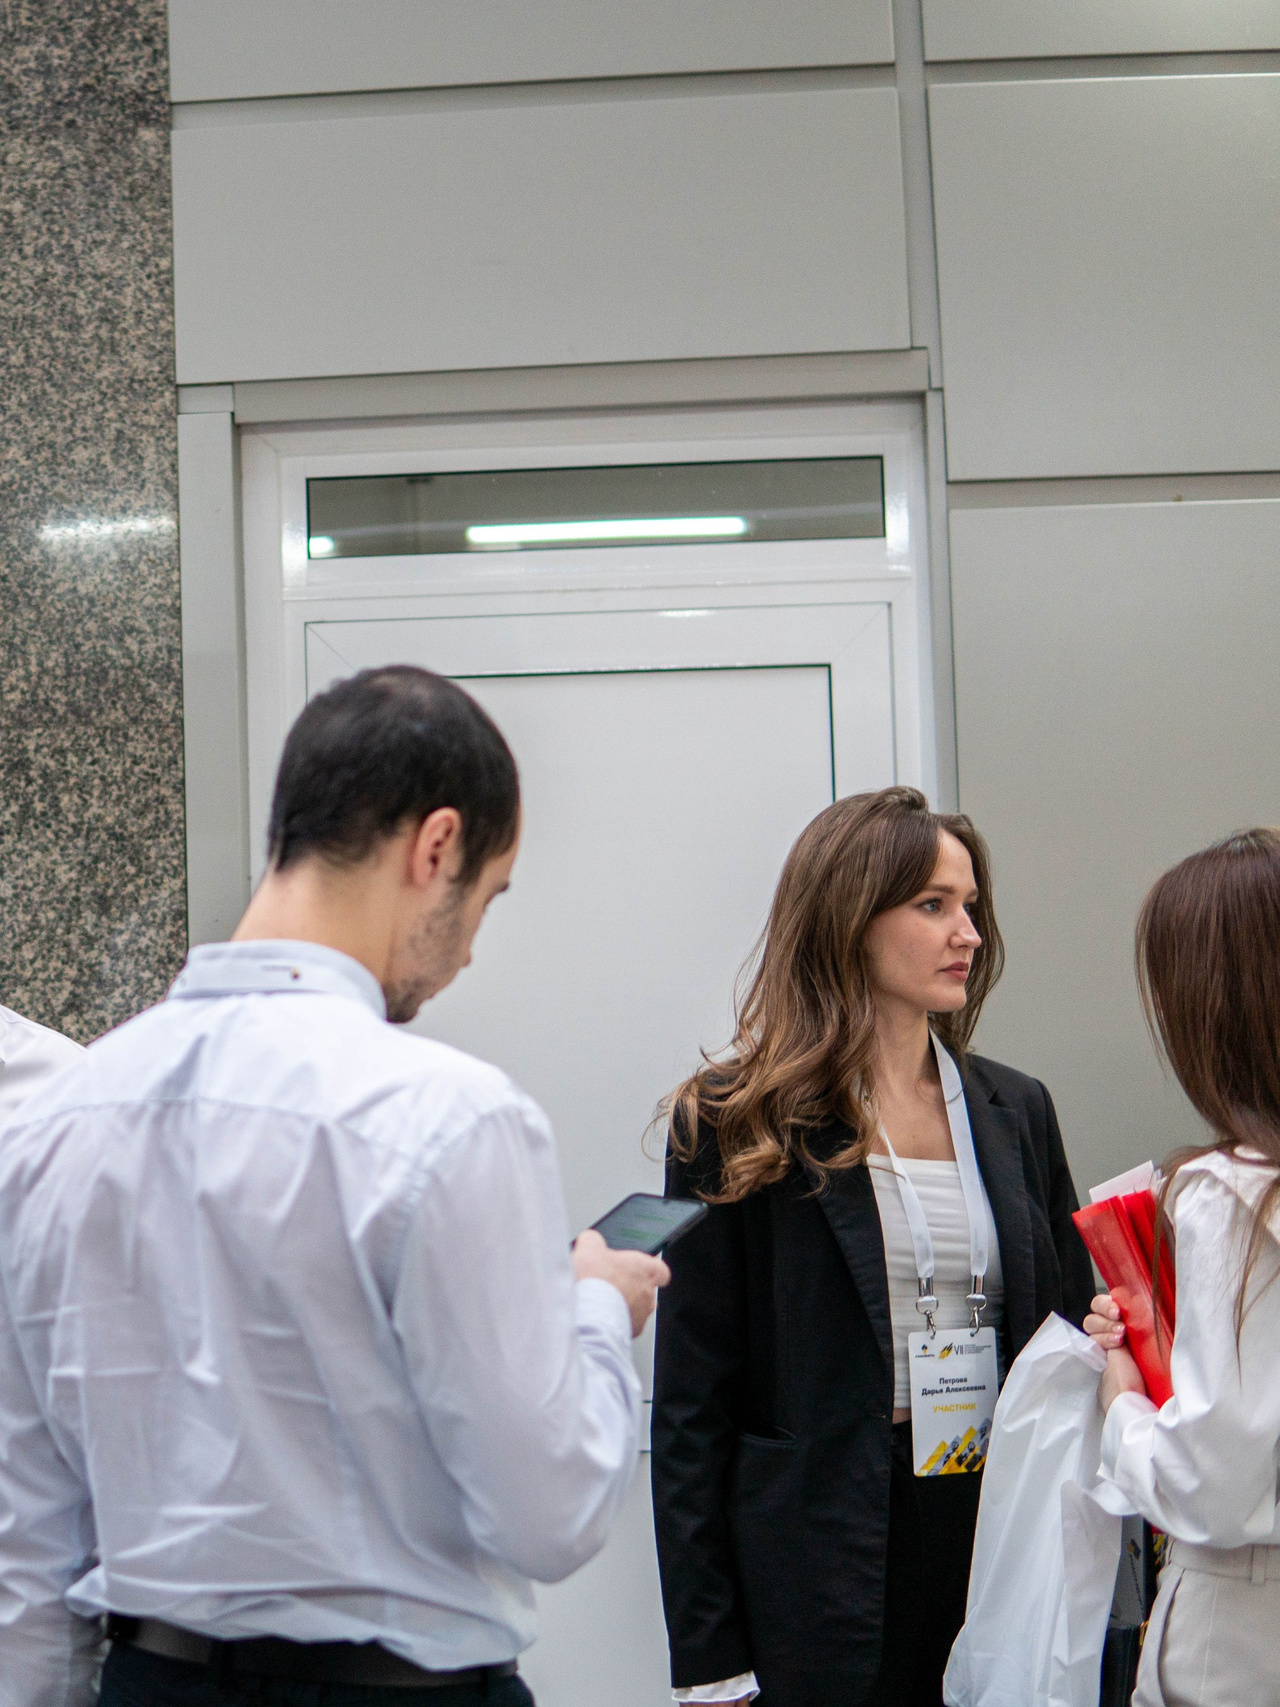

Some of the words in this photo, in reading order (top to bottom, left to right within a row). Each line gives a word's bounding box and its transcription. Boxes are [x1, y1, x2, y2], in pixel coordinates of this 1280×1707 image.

[939, 1377, 967, 1385] Петрова
[922, 1387, 943, 1396] Дарья
[945, 1384, 986, 1393] Алексеевна
[934, 1403, 976, 1413] УЧАСТНИК
